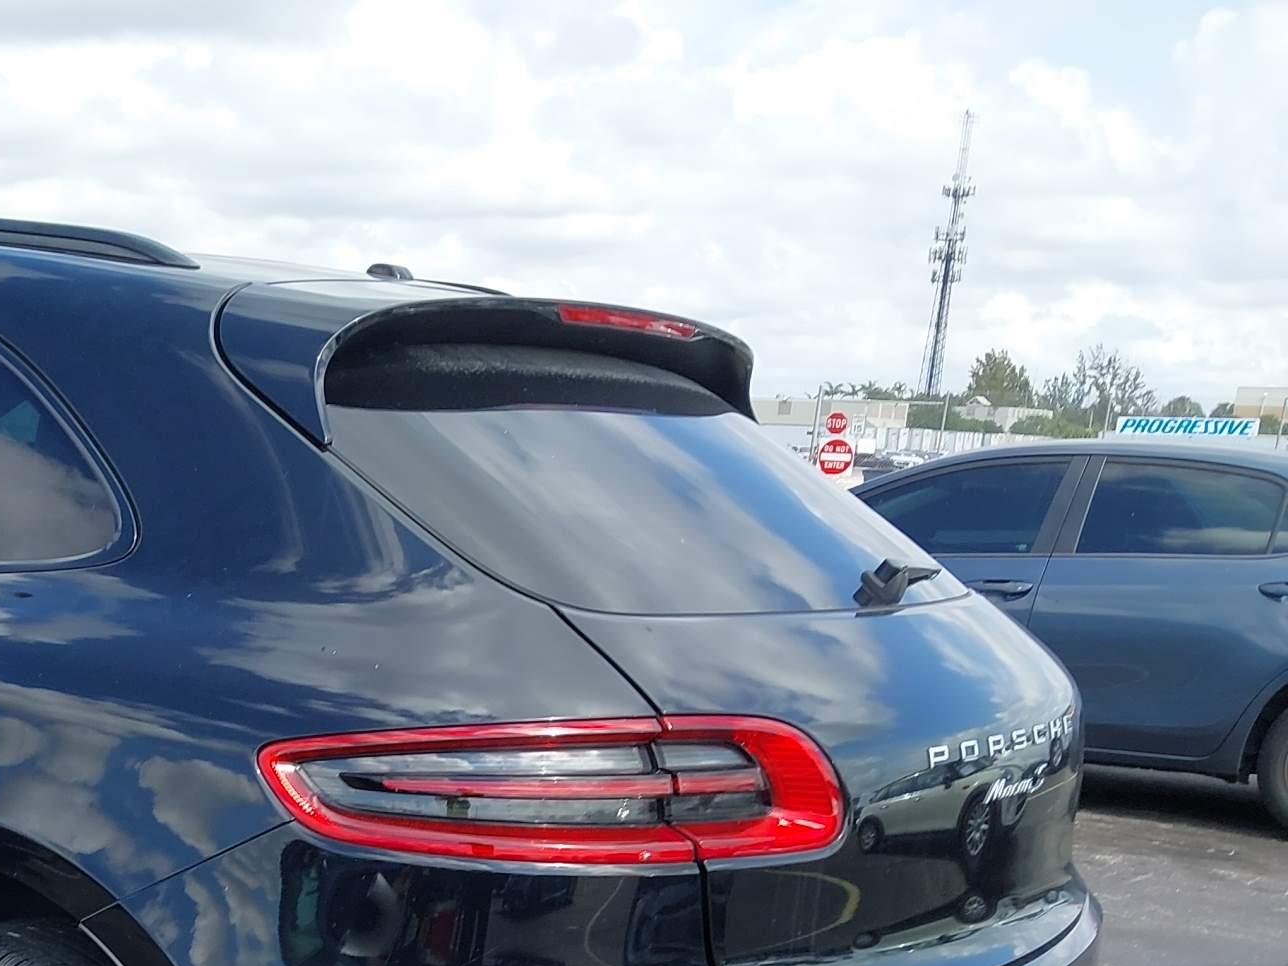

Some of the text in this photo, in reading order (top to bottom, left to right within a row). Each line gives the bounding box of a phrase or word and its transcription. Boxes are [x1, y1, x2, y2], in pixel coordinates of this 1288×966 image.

[827, 418, 847, 428] STOP
[1119, 417, 1257, 435] PROGRESSIVE
[824, 461, 845, 469] ENTER
[928, 714, 1073, 768] PORSCHE
[982, 763, 1049, 804] Macan S
